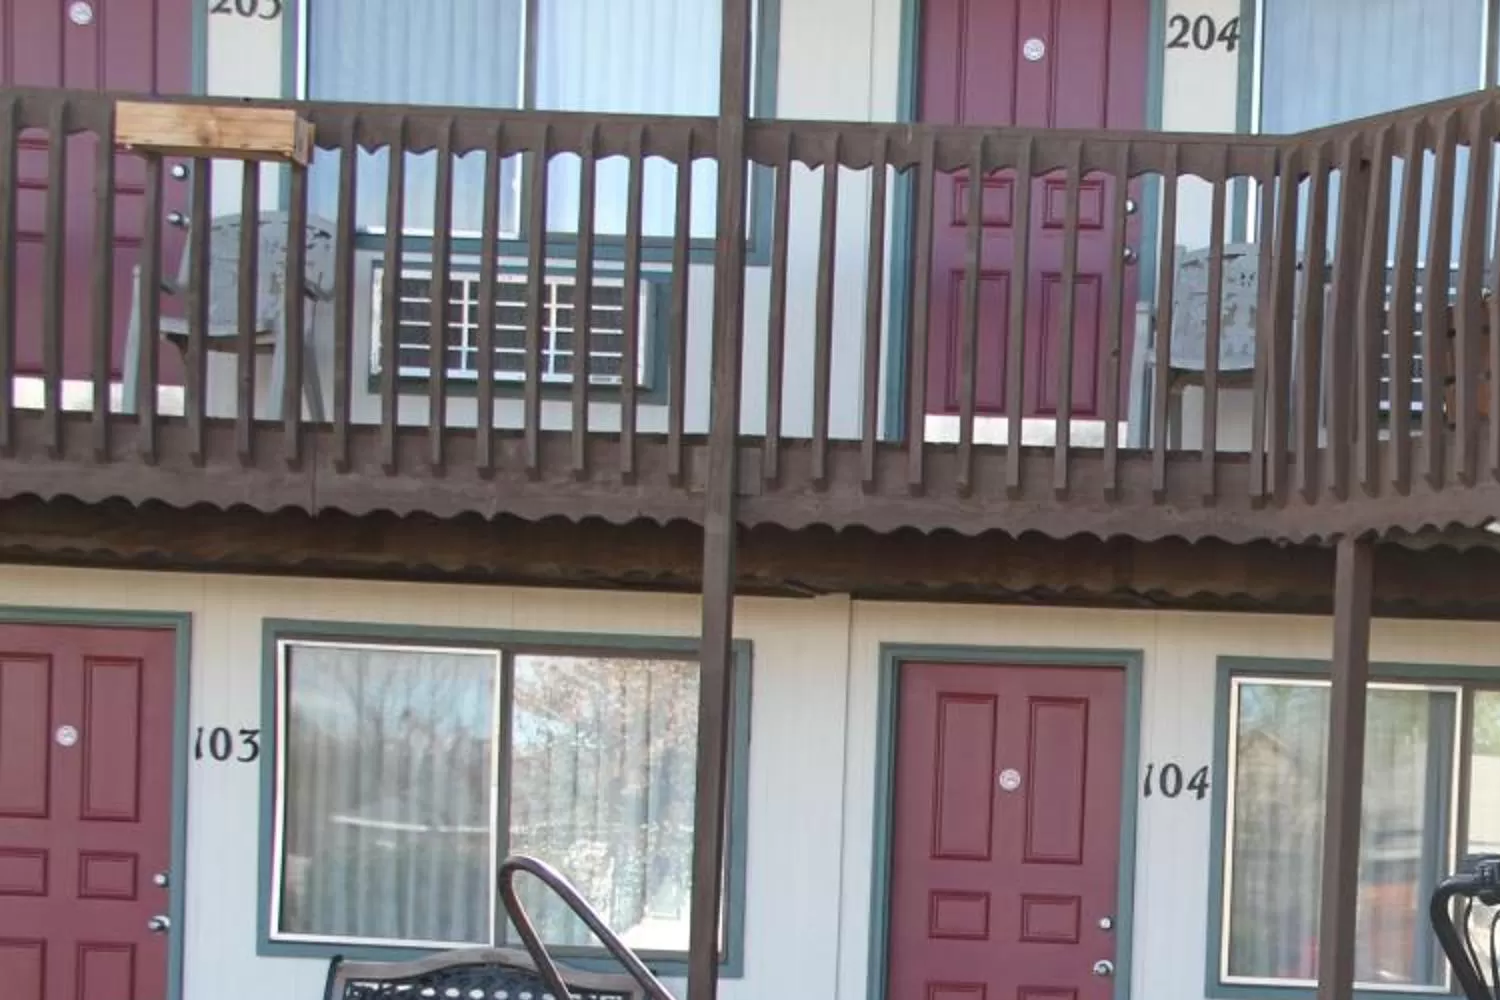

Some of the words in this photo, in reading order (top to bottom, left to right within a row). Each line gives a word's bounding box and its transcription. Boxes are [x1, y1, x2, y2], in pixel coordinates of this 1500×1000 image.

[1167, 13, 1240, 52] 204
[195, 726, 261, 763] 103
[1143, 762, 1209, 801] 104
